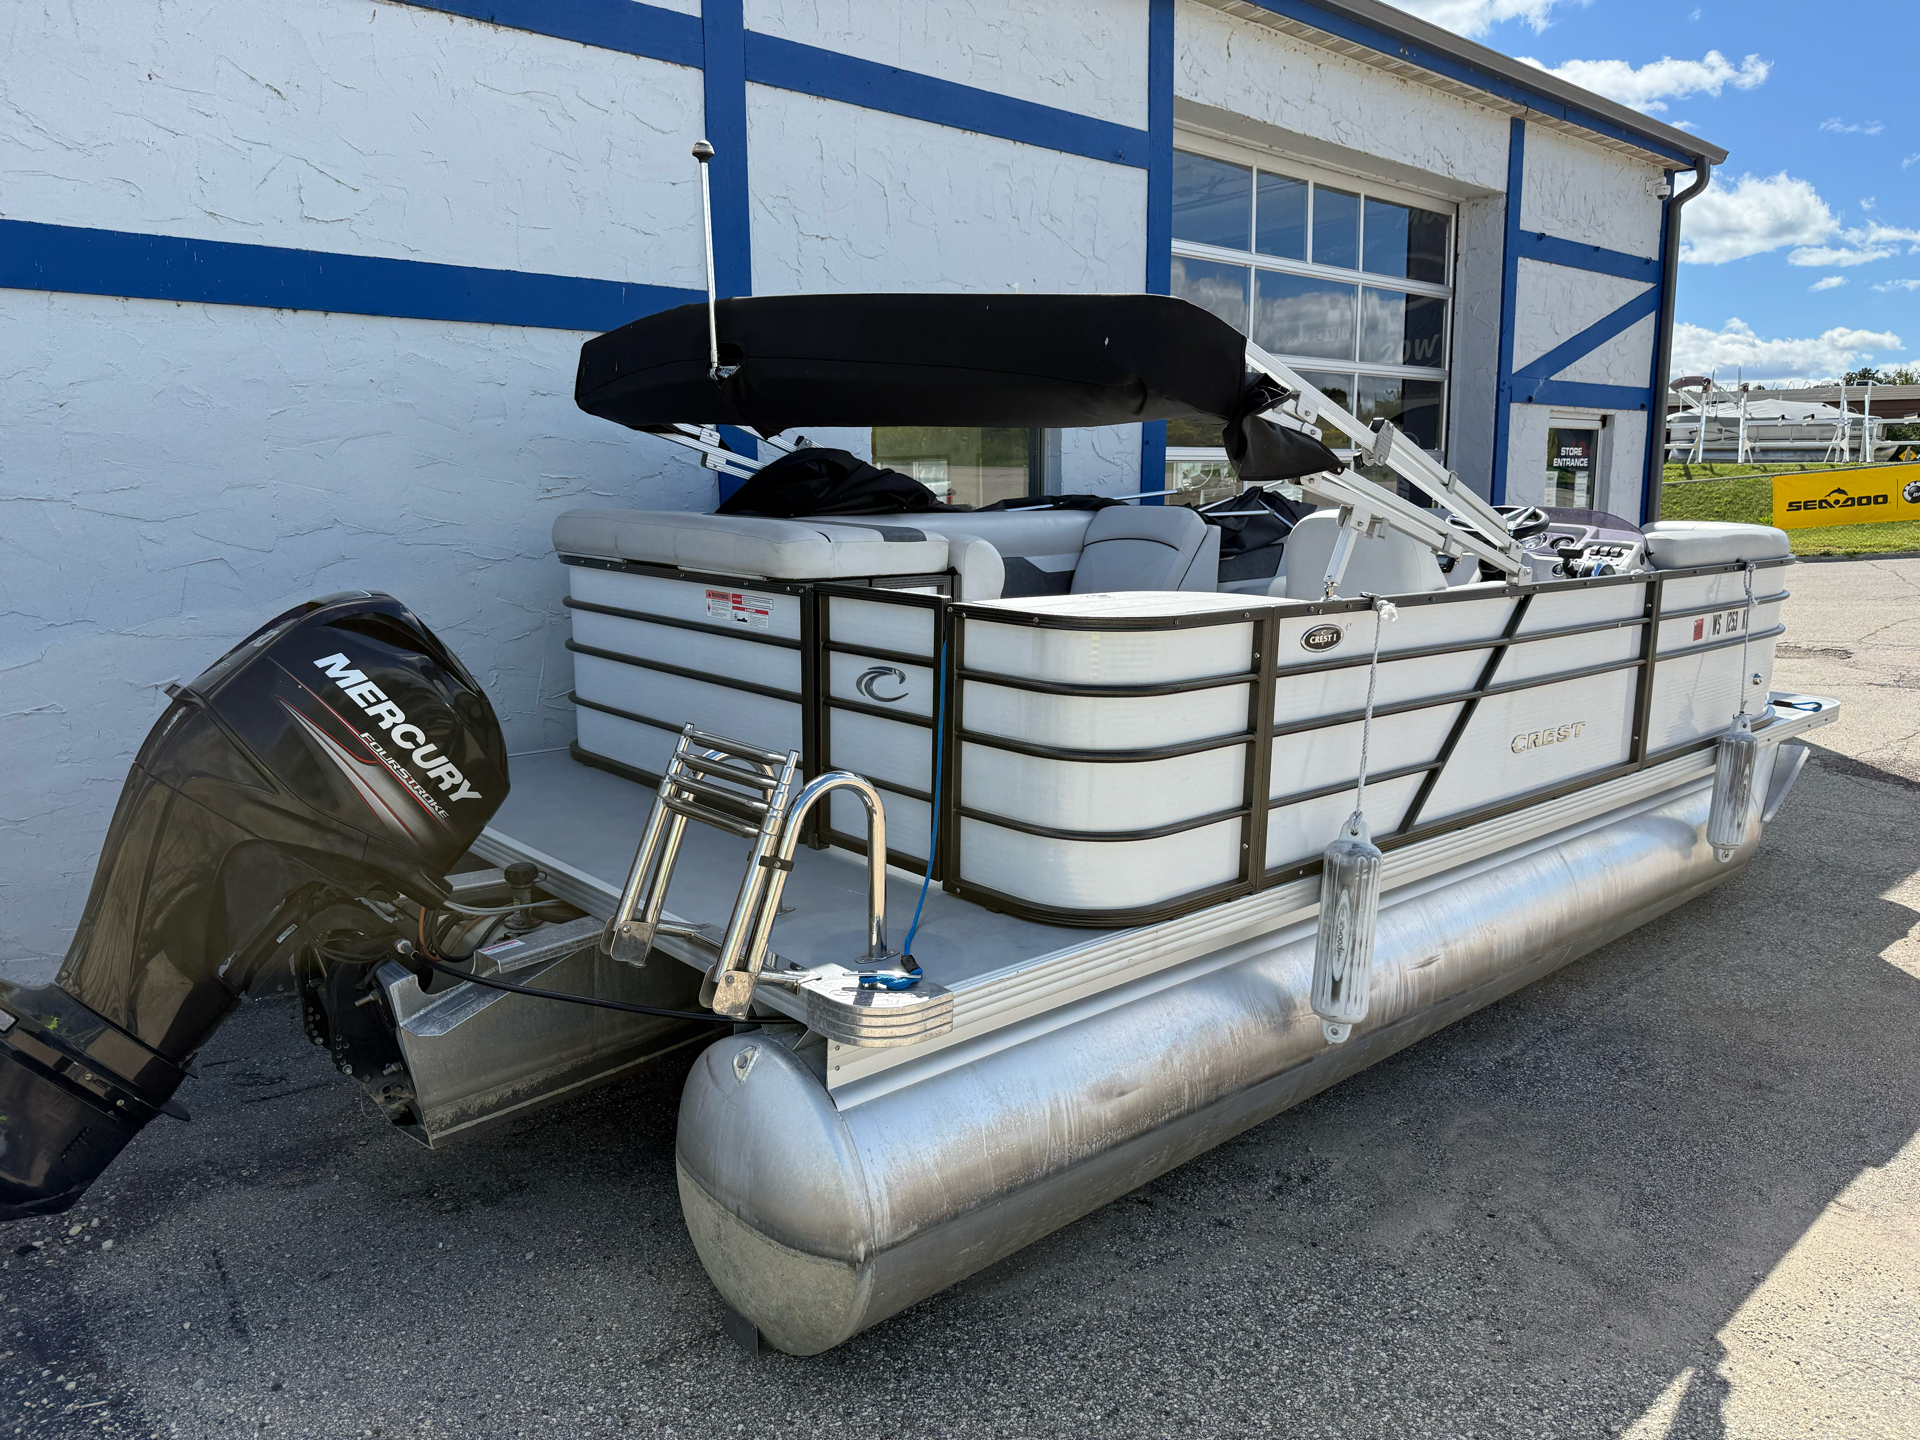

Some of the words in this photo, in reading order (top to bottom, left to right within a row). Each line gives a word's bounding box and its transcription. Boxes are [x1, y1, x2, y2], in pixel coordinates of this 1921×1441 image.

[1560, 447, 1583, 456] STORE
[1553, 458, 1588, 467] ENTRANCE
[1310, 635, 1332, 644] CREST
[313, 652, 483, 802] MERCURY
[1510, 720, 1586, 754] CREST
[359, 731, 450, 819] FOURSTROKE
